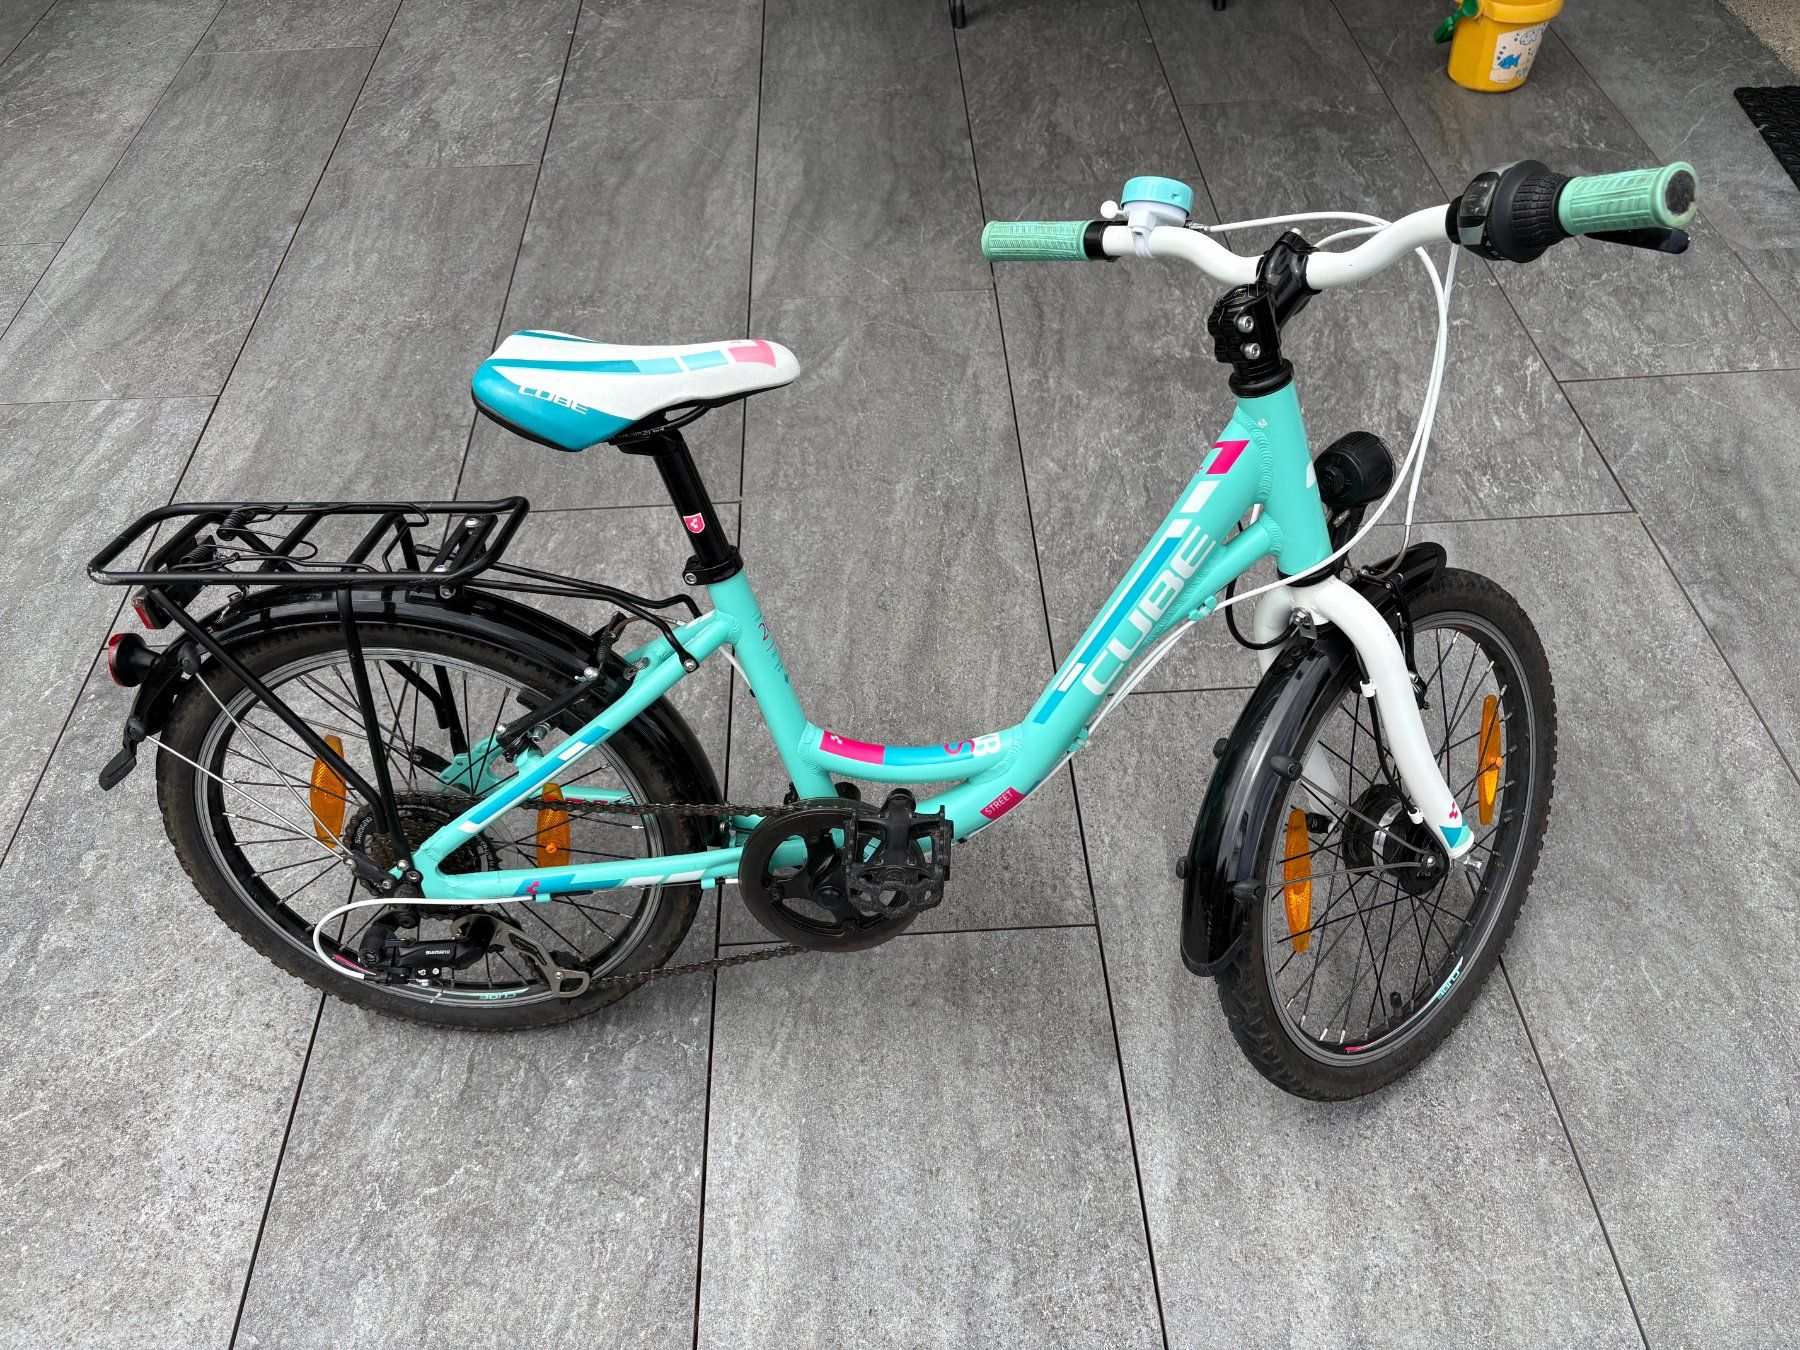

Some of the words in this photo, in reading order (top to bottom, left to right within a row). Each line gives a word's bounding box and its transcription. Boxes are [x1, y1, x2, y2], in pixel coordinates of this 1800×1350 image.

[518, 385, 587, 415] CUBE
[1081, 525, 1216, 696] CUBE
[984, 789, 1013, 815] STREET
